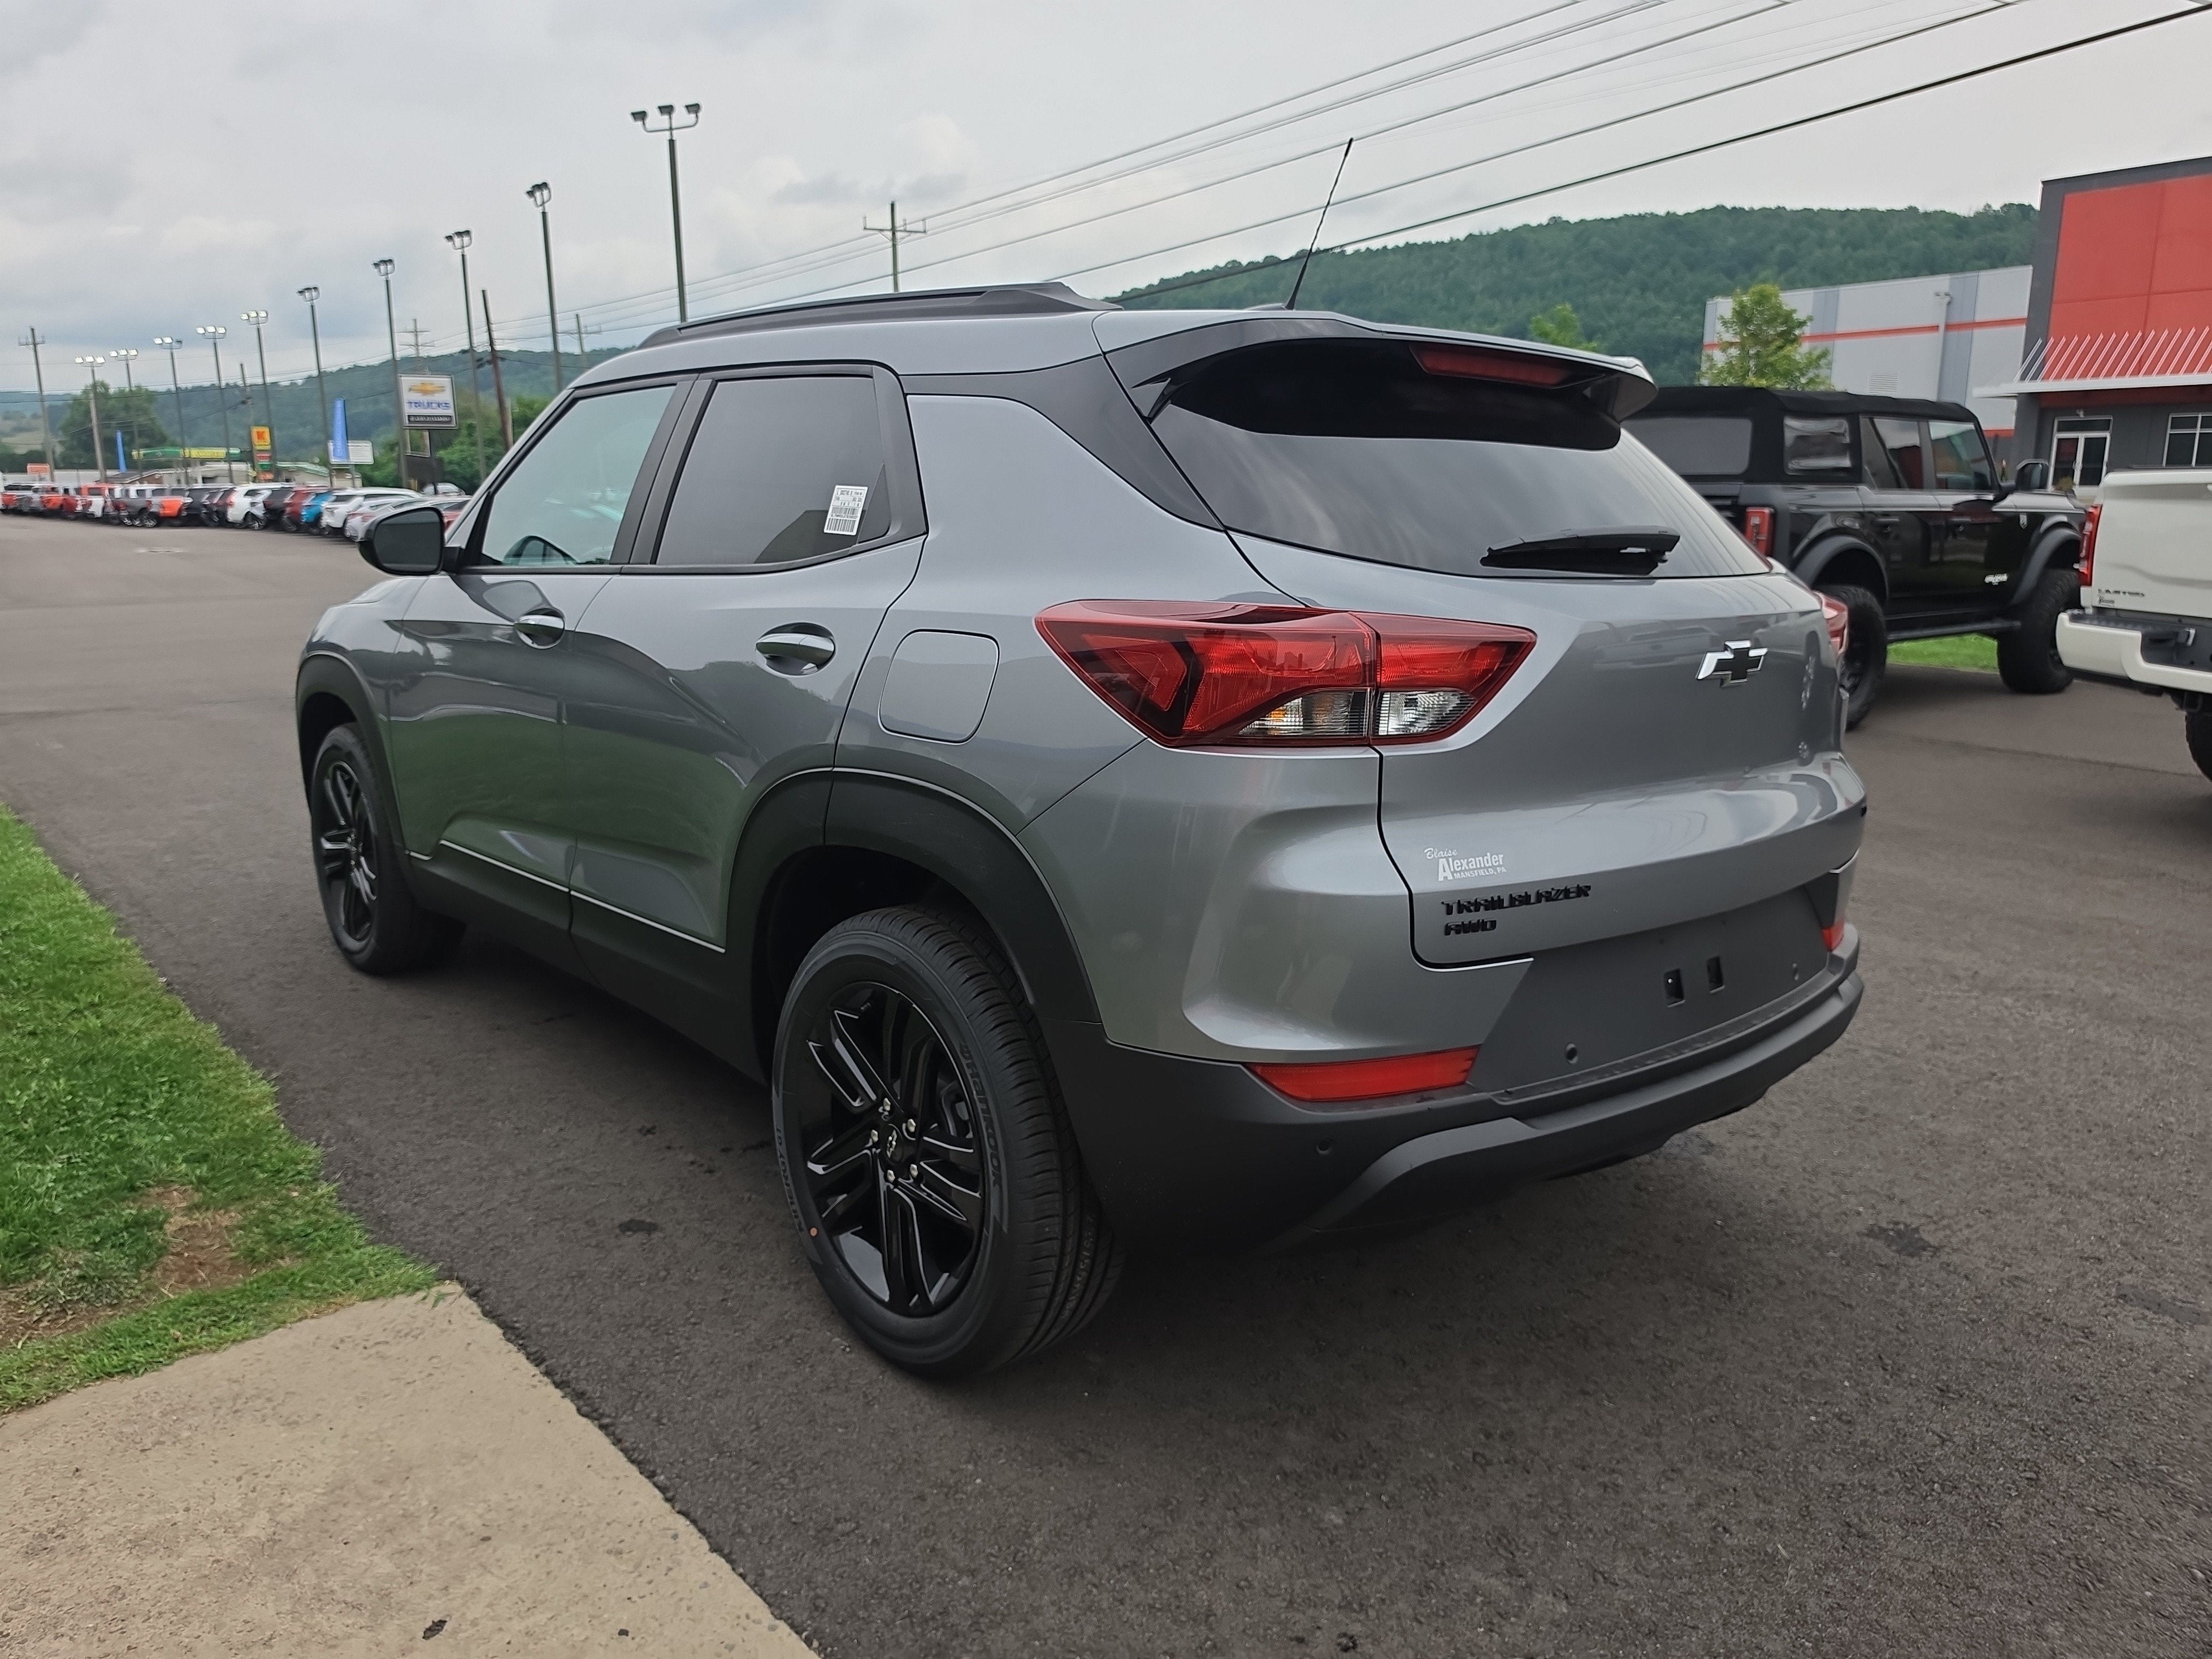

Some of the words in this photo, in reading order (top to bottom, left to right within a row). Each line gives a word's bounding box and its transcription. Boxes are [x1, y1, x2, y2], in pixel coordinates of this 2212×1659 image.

[407, 401, 449, 410] TRUCKS
[1424, 847, 1458, 859] Blaise
[1438, 852, 1504, 881] Alexander
[1454, 868, 1496, 879] MANSFIELD,
[1441, 884, 1591, 915] TRAILBLAZER
[1444, 918, 1497, 936] AWD
